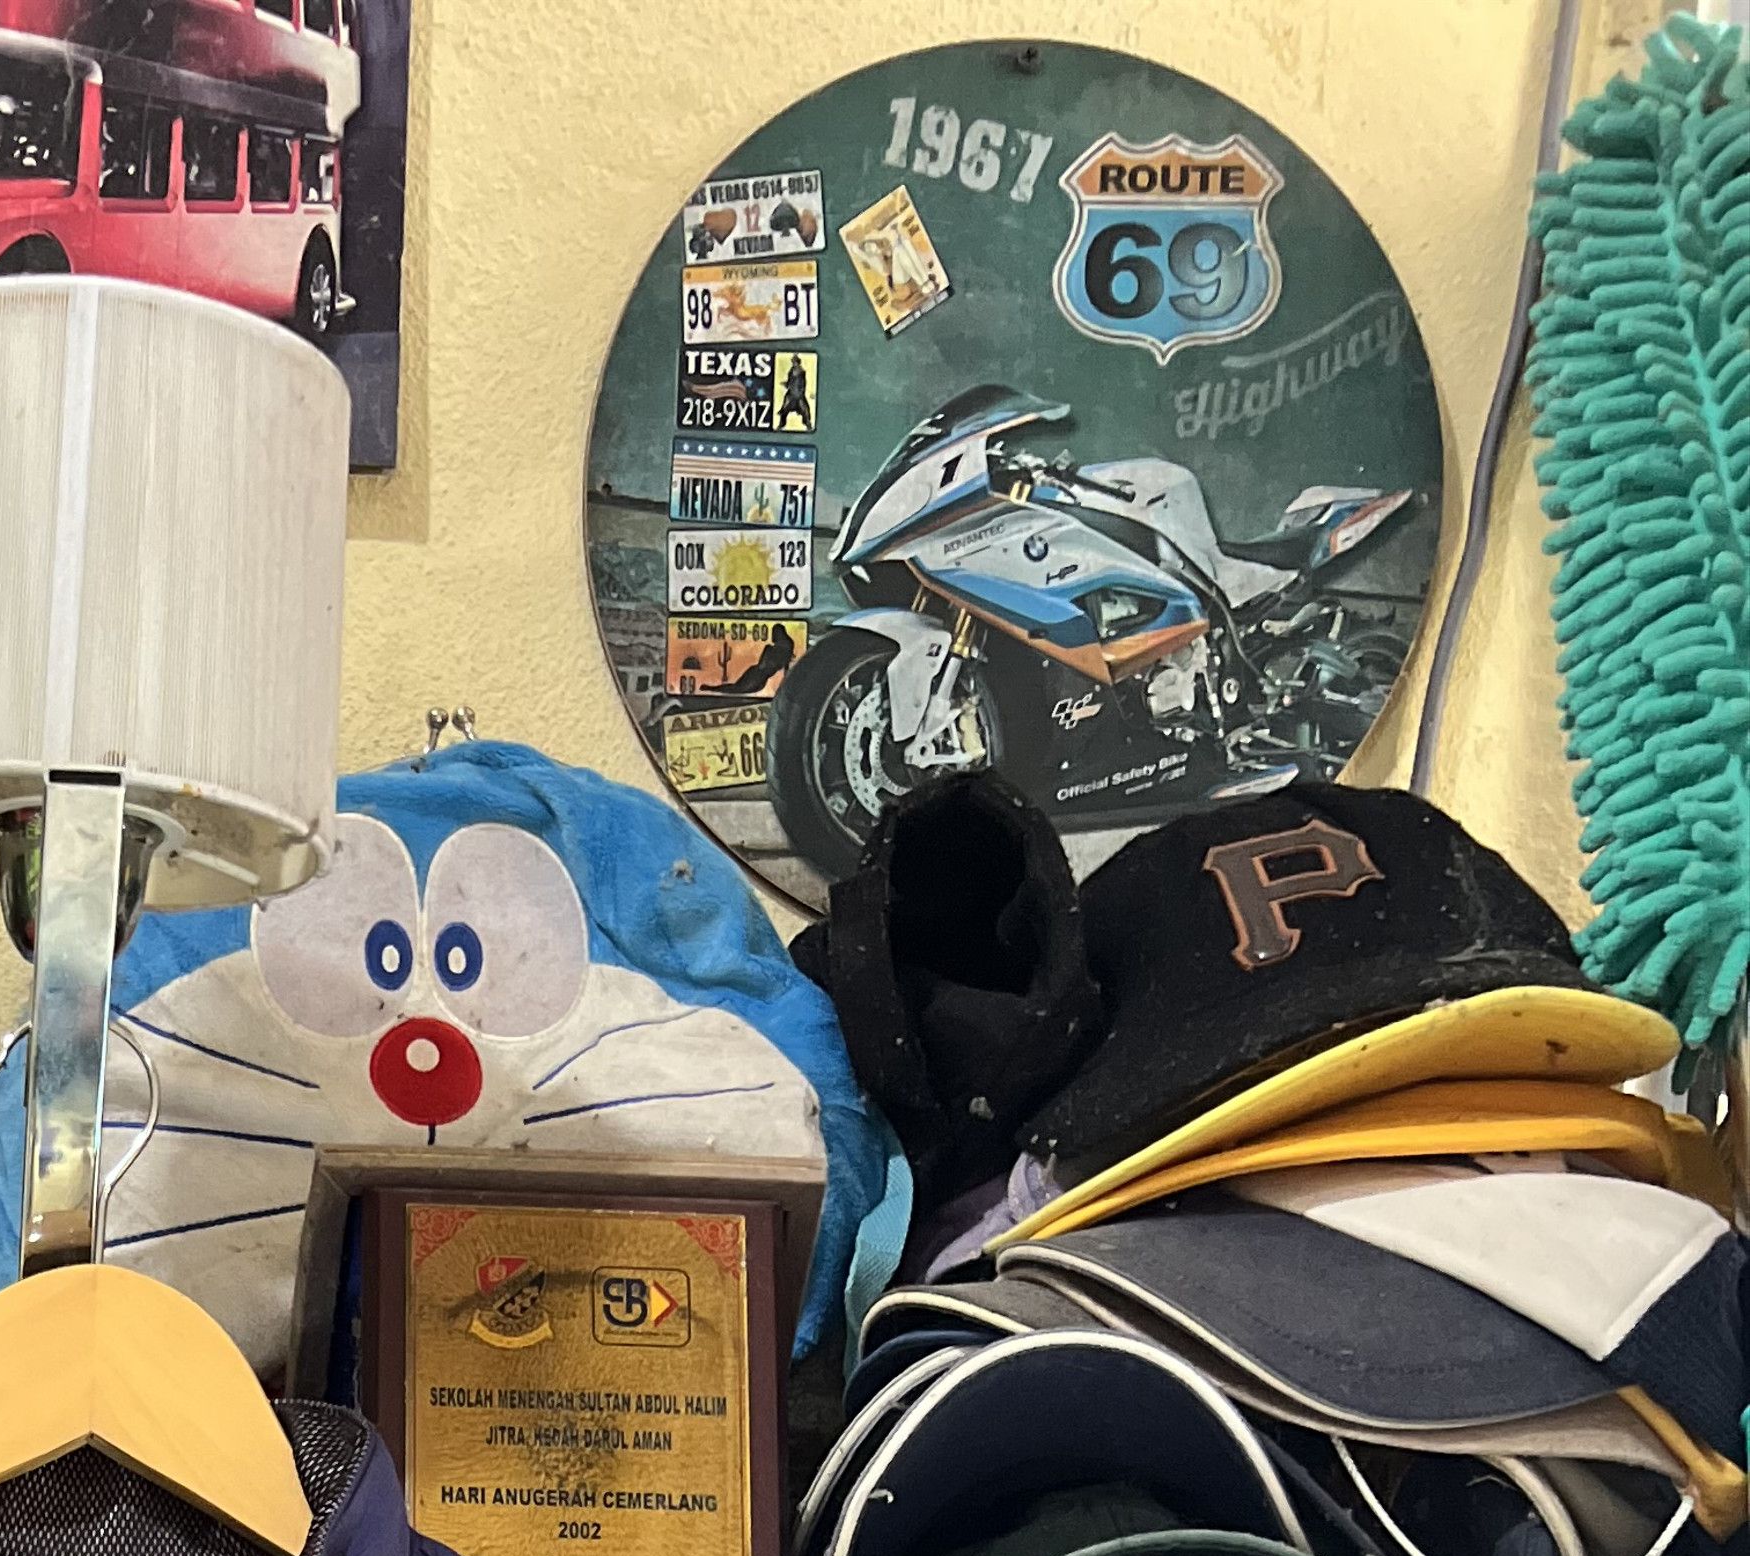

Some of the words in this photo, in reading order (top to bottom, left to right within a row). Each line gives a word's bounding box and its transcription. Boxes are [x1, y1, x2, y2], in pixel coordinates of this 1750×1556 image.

[882, 97, 1053, 203] 1967
[1100, 164, 1246, 195] ROUTE
[1084, 222, 1249, 321] 69
[687, 288, 713, 330] 98
[783, 282, 816, 327] BT
[685, 351, 772, 377] TEXAS
[1173, 300, 1408, 439] Highway
[679, 476, 743, 521] NEVADA
[780, 484, 808, 526] 751
[779, 541, 806, 568] 123
[681, 583, 800, 608] COLORADO
[739, 731, 765, 778] 66
[1057, 774, 1109, 801] Official
[1111, 762, 1158, 787] Safety
[1202, 817, 1387, 974] P
[429, 1386, 494, 1409] SEKOLAH
[497, 1388, 575, 1411] MENENGAH
[578, 1391, 632, 1413] SULTAN
[634, 1394, 681, 1415] ABDUL
[684, 1396, 728, 1417] HALIM
[583, 1428, 629, 1450] DARUL
[632, 1430, 673, 1452] AMAN
[440, 1485, 487, 1505] HARI
[491, 1487, 597, 1509] ANUGERAH
[602, 1490, 718, 1513] CEMERLANG
[557, 1521, 603, 1541] 2002
